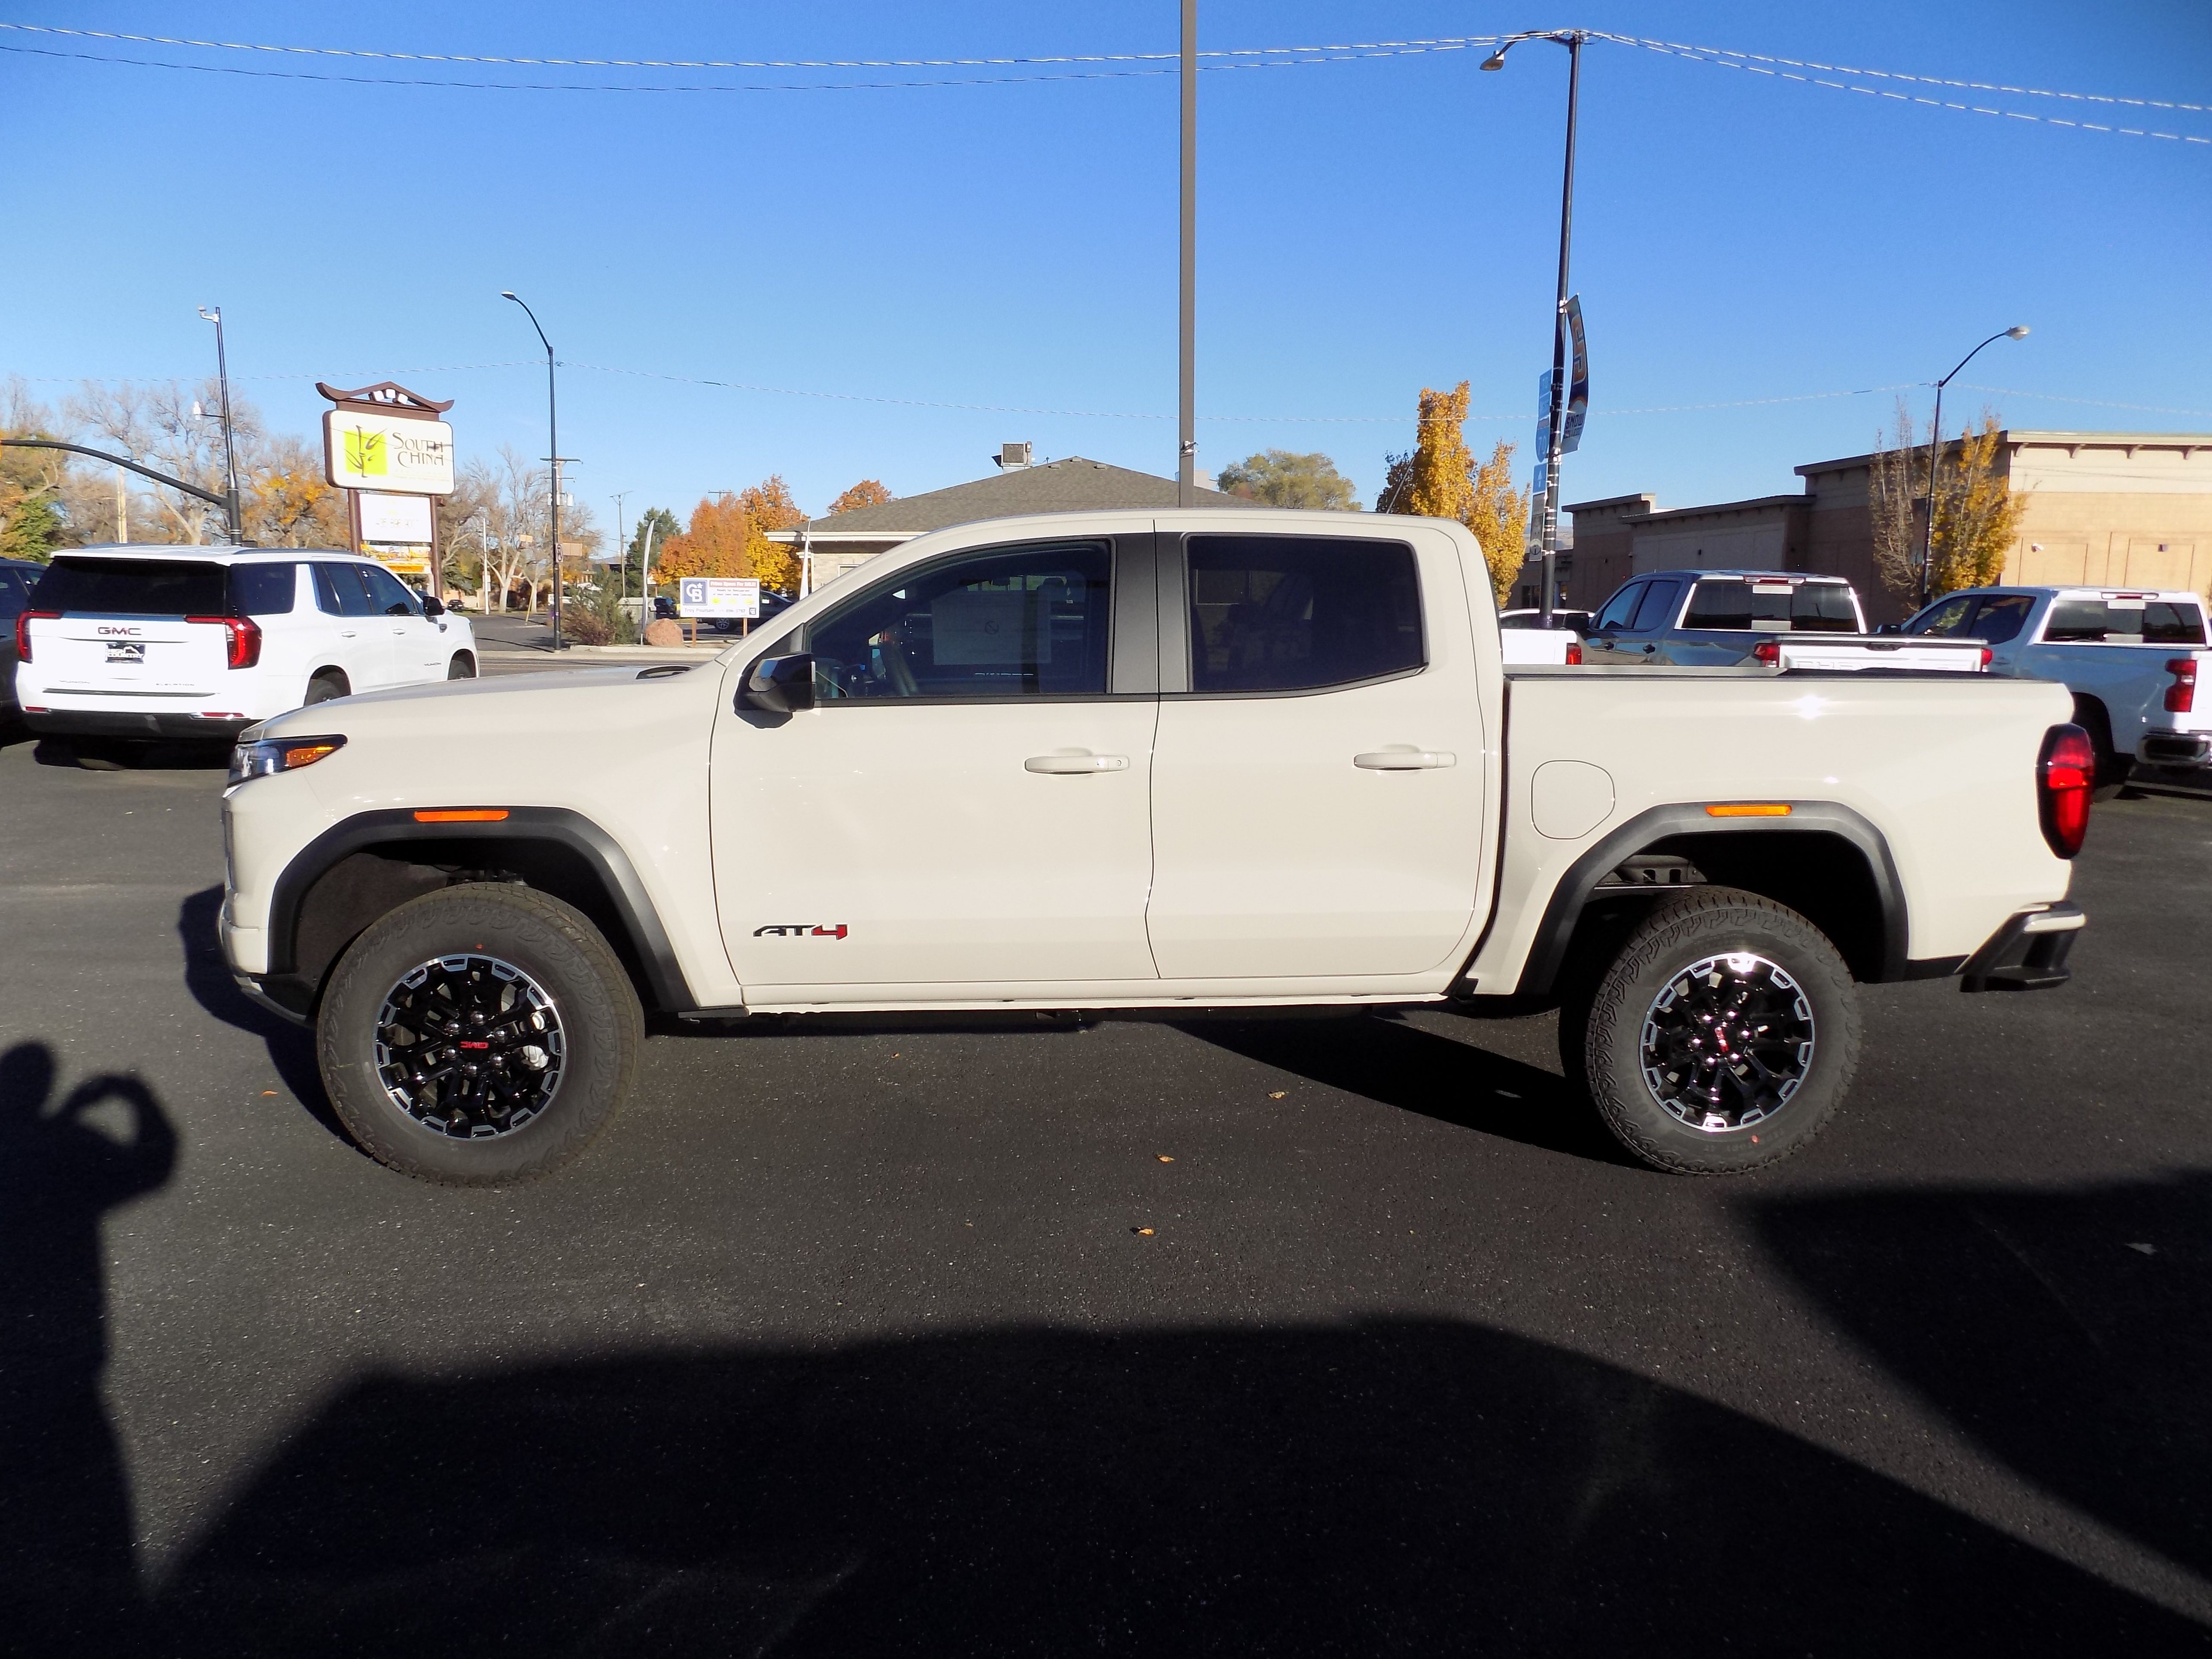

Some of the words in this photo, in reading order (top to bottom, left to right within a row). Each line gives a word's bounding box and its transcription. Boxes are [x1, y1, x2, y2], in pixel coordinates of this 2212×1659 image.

[1566, 413, 1584, 429] SNOW
[392, 432, 444, 453] SOUTH
[1538, 435, 1547, 455] 70
[398, 451, 444, 468] CHINA
[98, 627, 142, 635] GMC
[753, 923, 848, 940] AT4
